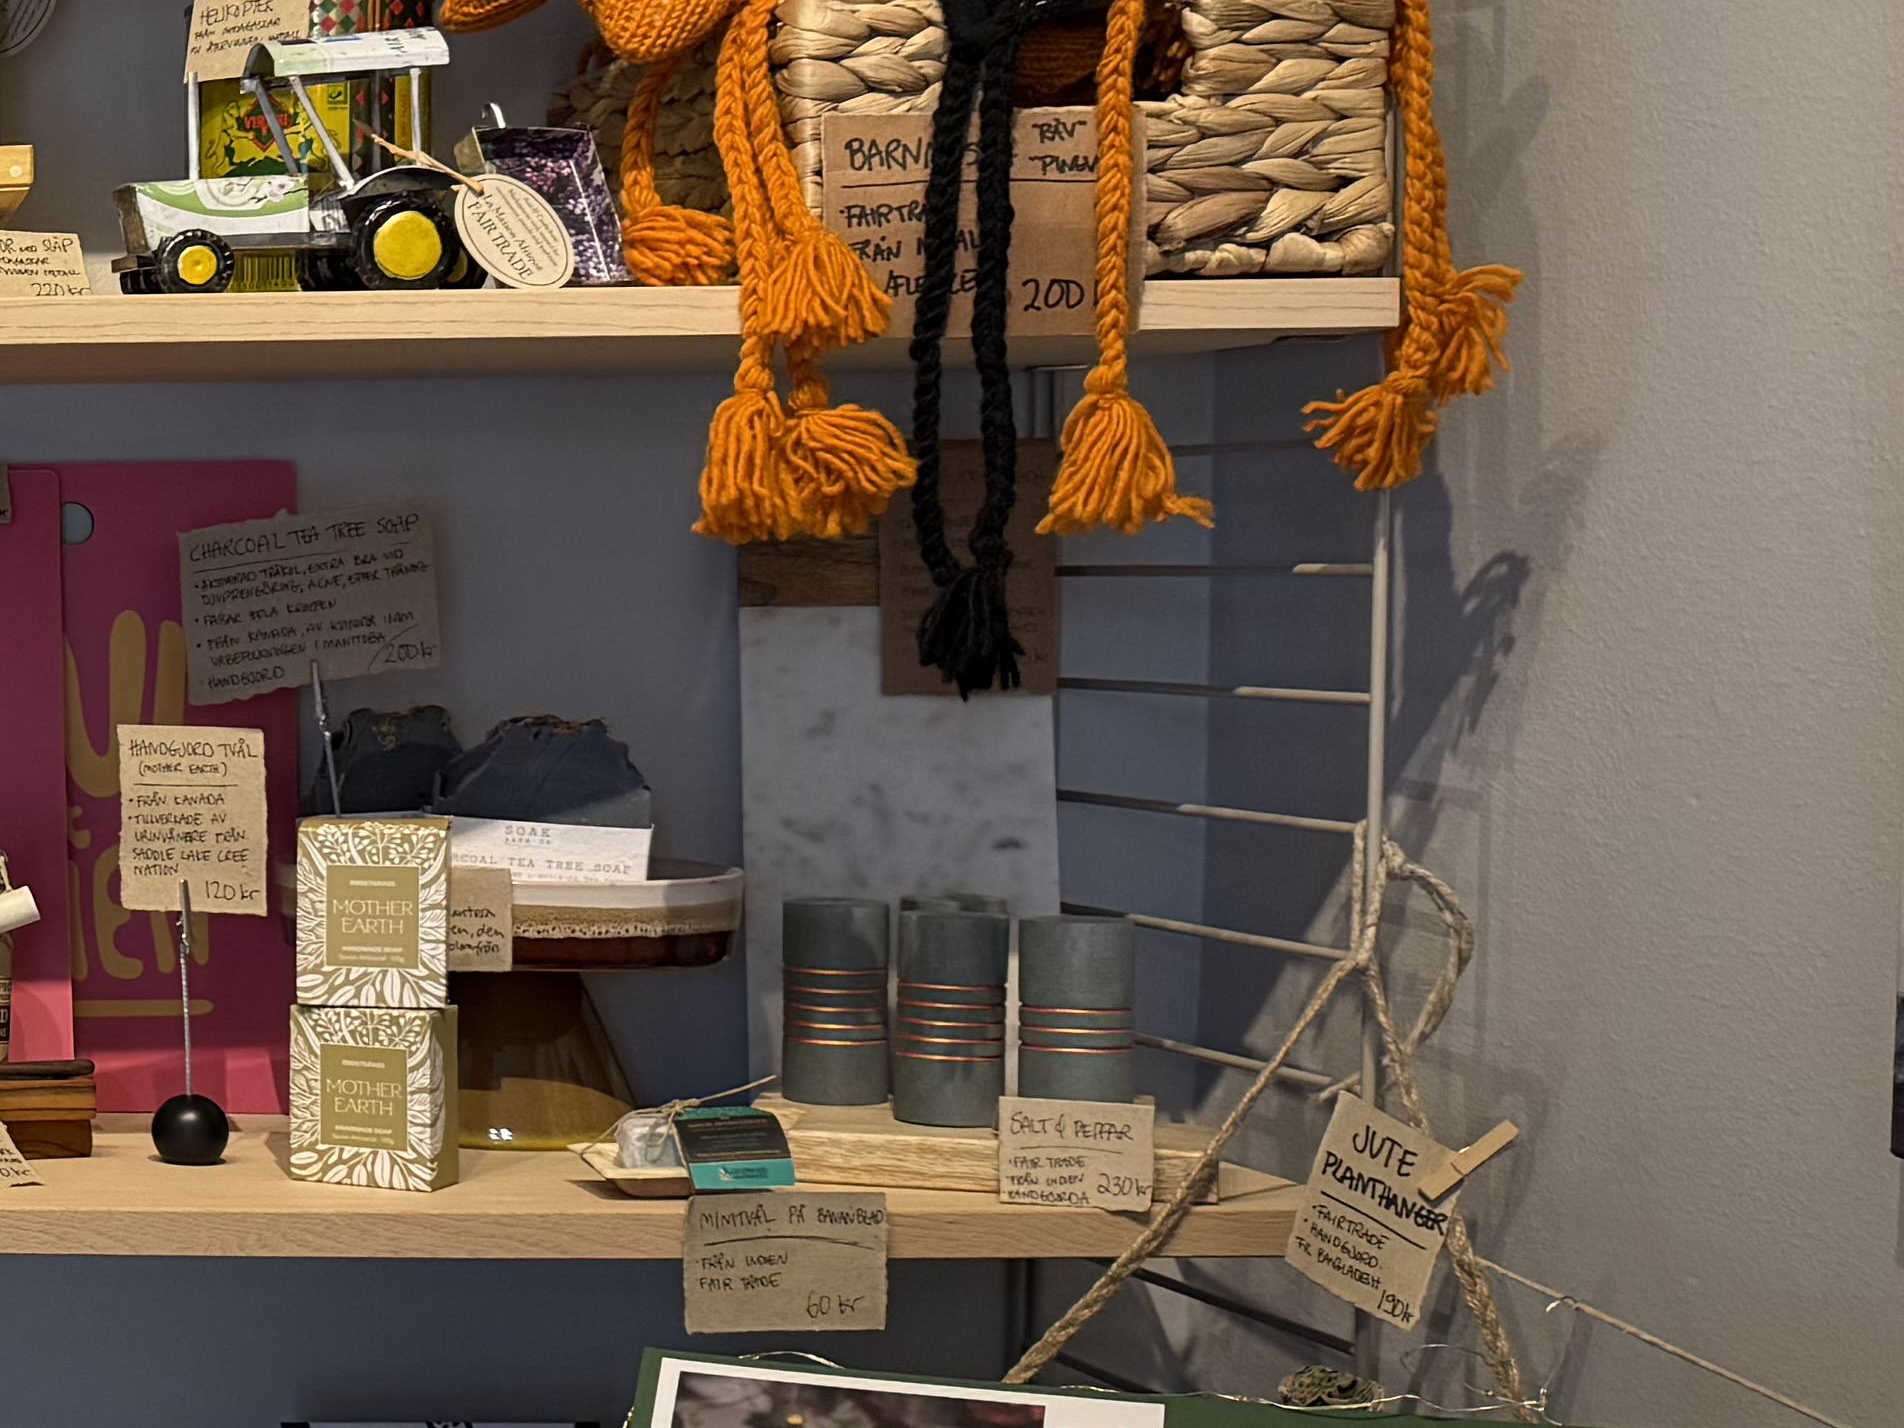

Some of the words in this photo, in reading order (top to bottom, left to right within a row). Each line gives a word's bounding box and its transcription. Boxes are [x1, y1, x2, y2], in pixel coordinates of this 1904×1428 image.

[467, 201, 500, 233] FAIR
[490, 228, 534, 281] TRADE
[1021, 279, 1085, 312] 200
[129, 737, 215, 761] HANDGJORD
[218, 736, 259, 761] TVÅL
[204, 879, 233, 903] 120
[236, 882, 259, 902] kr
[332, 900, 414, 917] MOTHER
[340, 917, 405, 936] EARTH
[1352, 1124, 1418, 1177] JUTE
